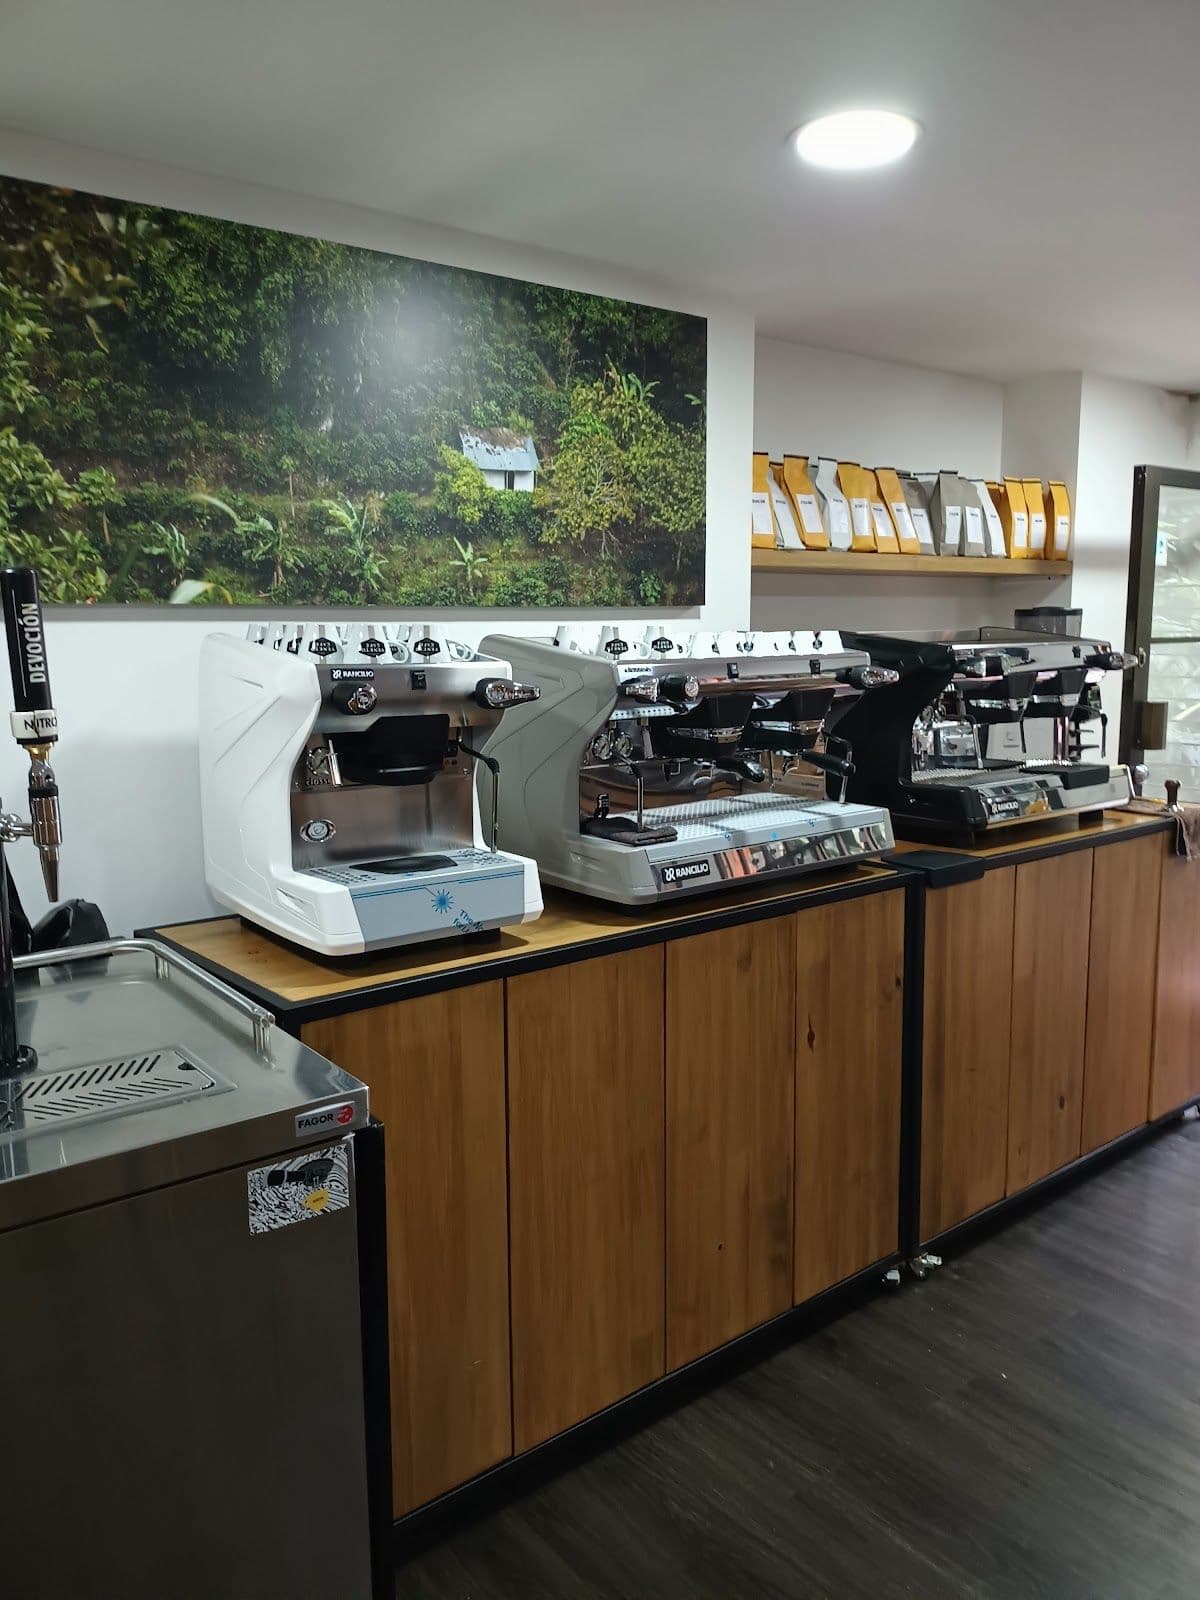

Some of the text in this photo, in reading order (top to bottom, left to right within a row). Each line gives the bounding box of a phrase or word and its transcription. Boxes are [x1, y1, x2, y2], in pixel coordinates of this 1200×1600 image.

[18, 603, 46, 683] DEVOCIÓN
[342, 670, 374, 678] RANCILIO
[24, 716, 58, 730] NITRO
[676, 863, 708, 878] RANCILIO
[298, 1113, 334, 1128] FAGOR
